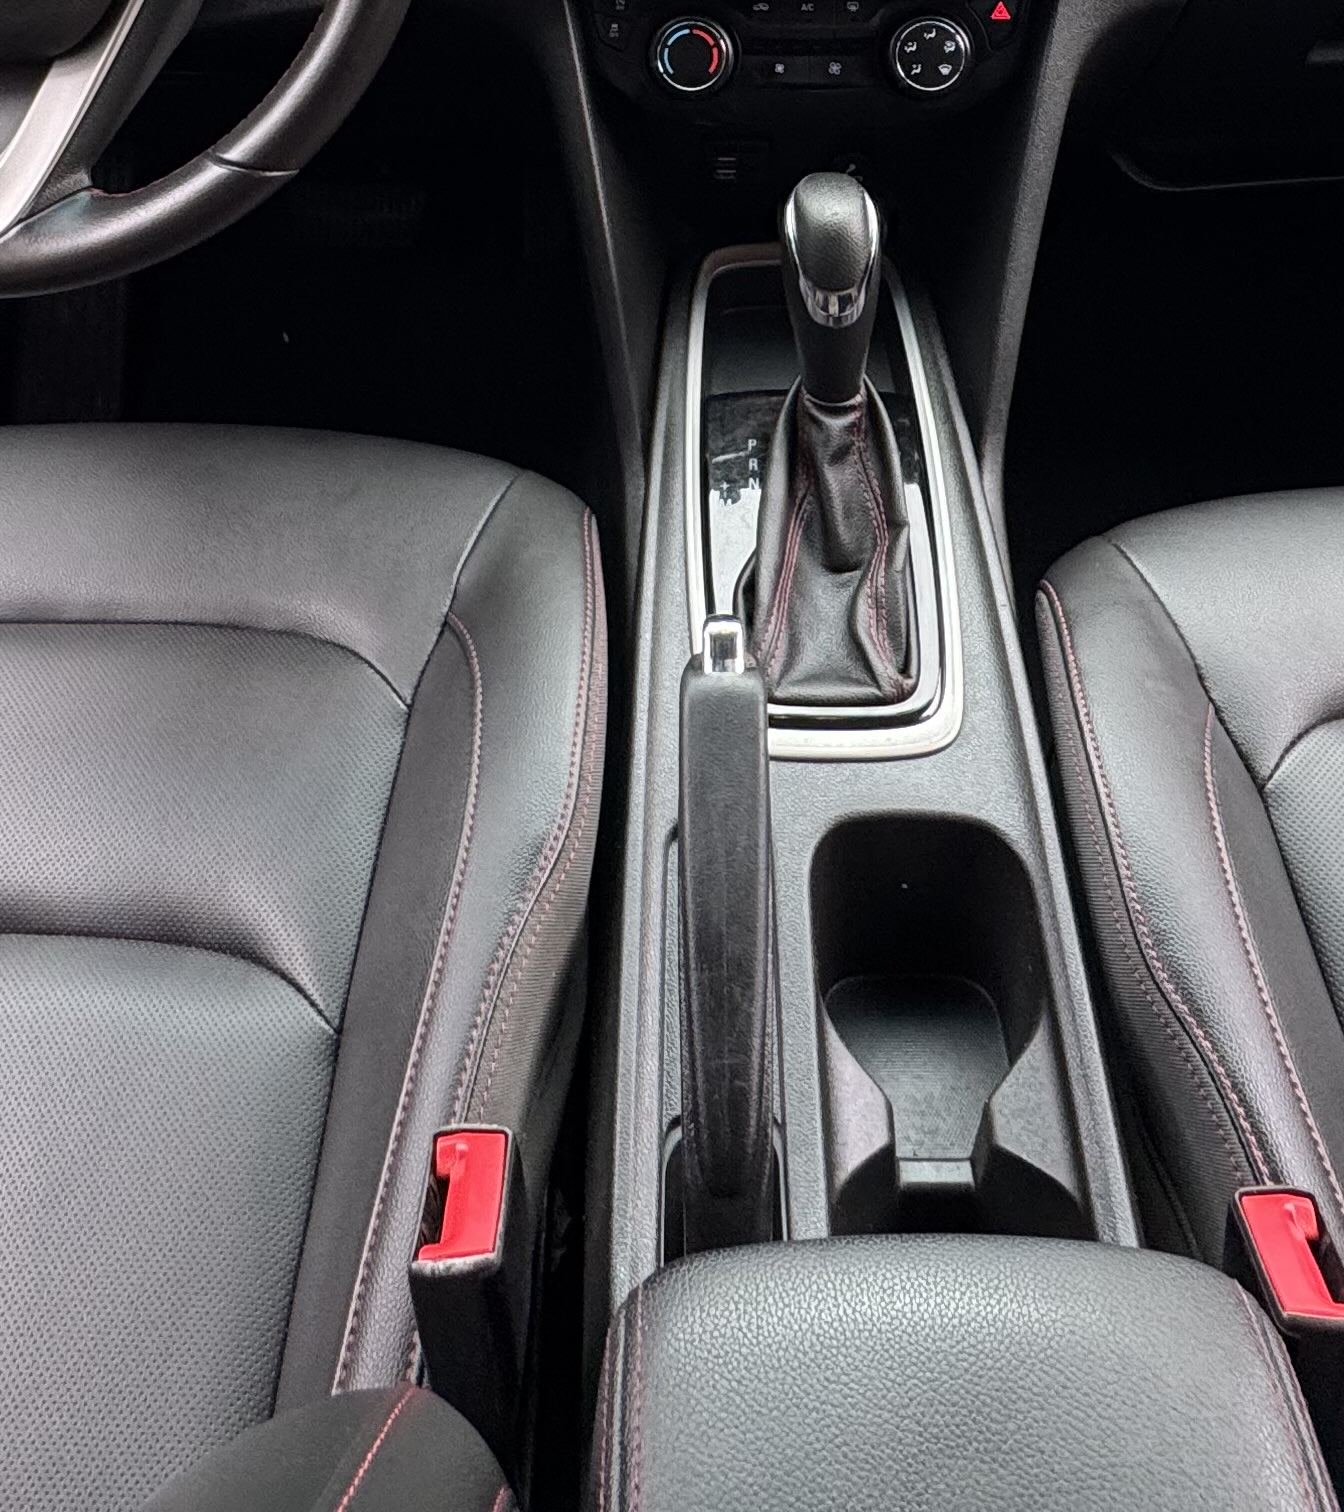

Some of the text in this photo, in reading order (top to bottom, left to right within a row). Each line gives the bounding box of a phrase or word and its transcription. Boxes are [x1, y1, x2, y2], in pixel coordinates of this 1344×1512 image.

[747, 439, 758, 452] P
[748, 458, 759, 471] R
[748, 477, 760, 490] N
